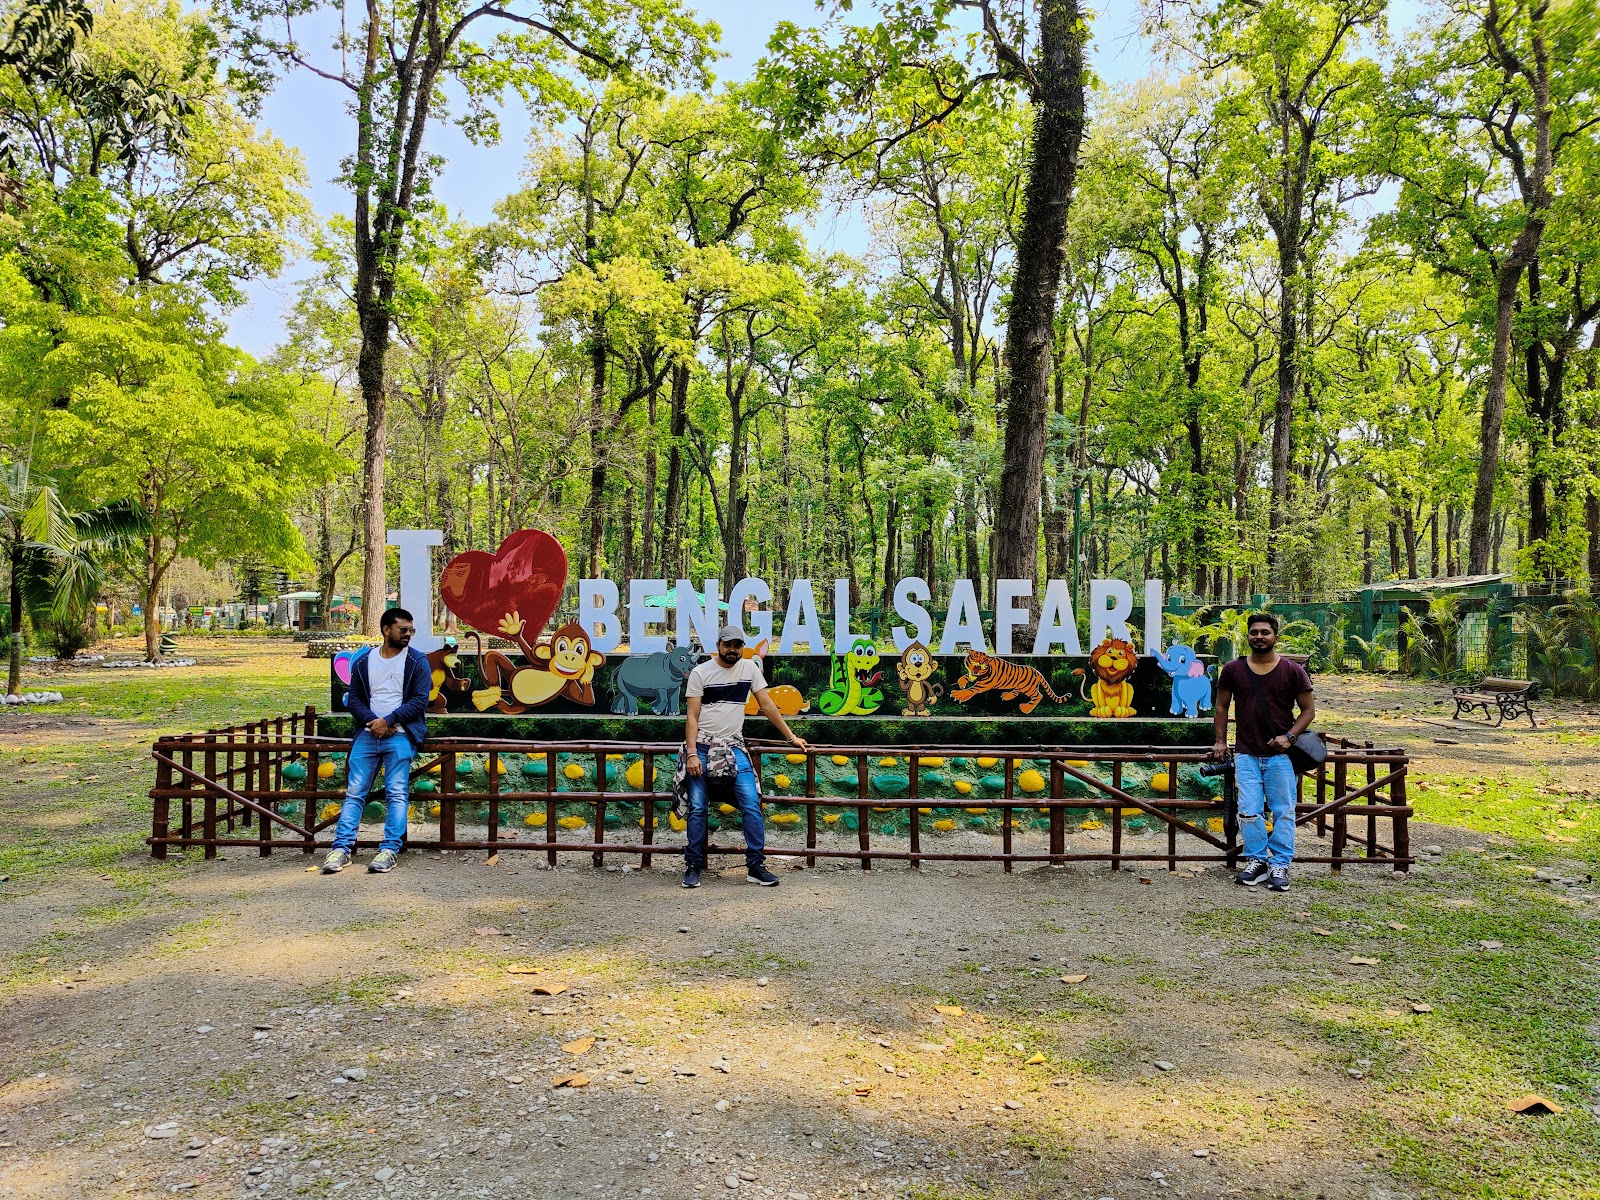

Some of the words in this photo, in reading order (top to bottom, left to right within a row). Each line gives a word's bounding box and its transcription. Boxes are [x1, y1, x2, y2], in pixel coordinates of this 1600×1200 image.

[386, 529, 444, 653] I
[578, 577, 871, 654] BENGAL
[892, 577, 1163, 655] SAFARI
